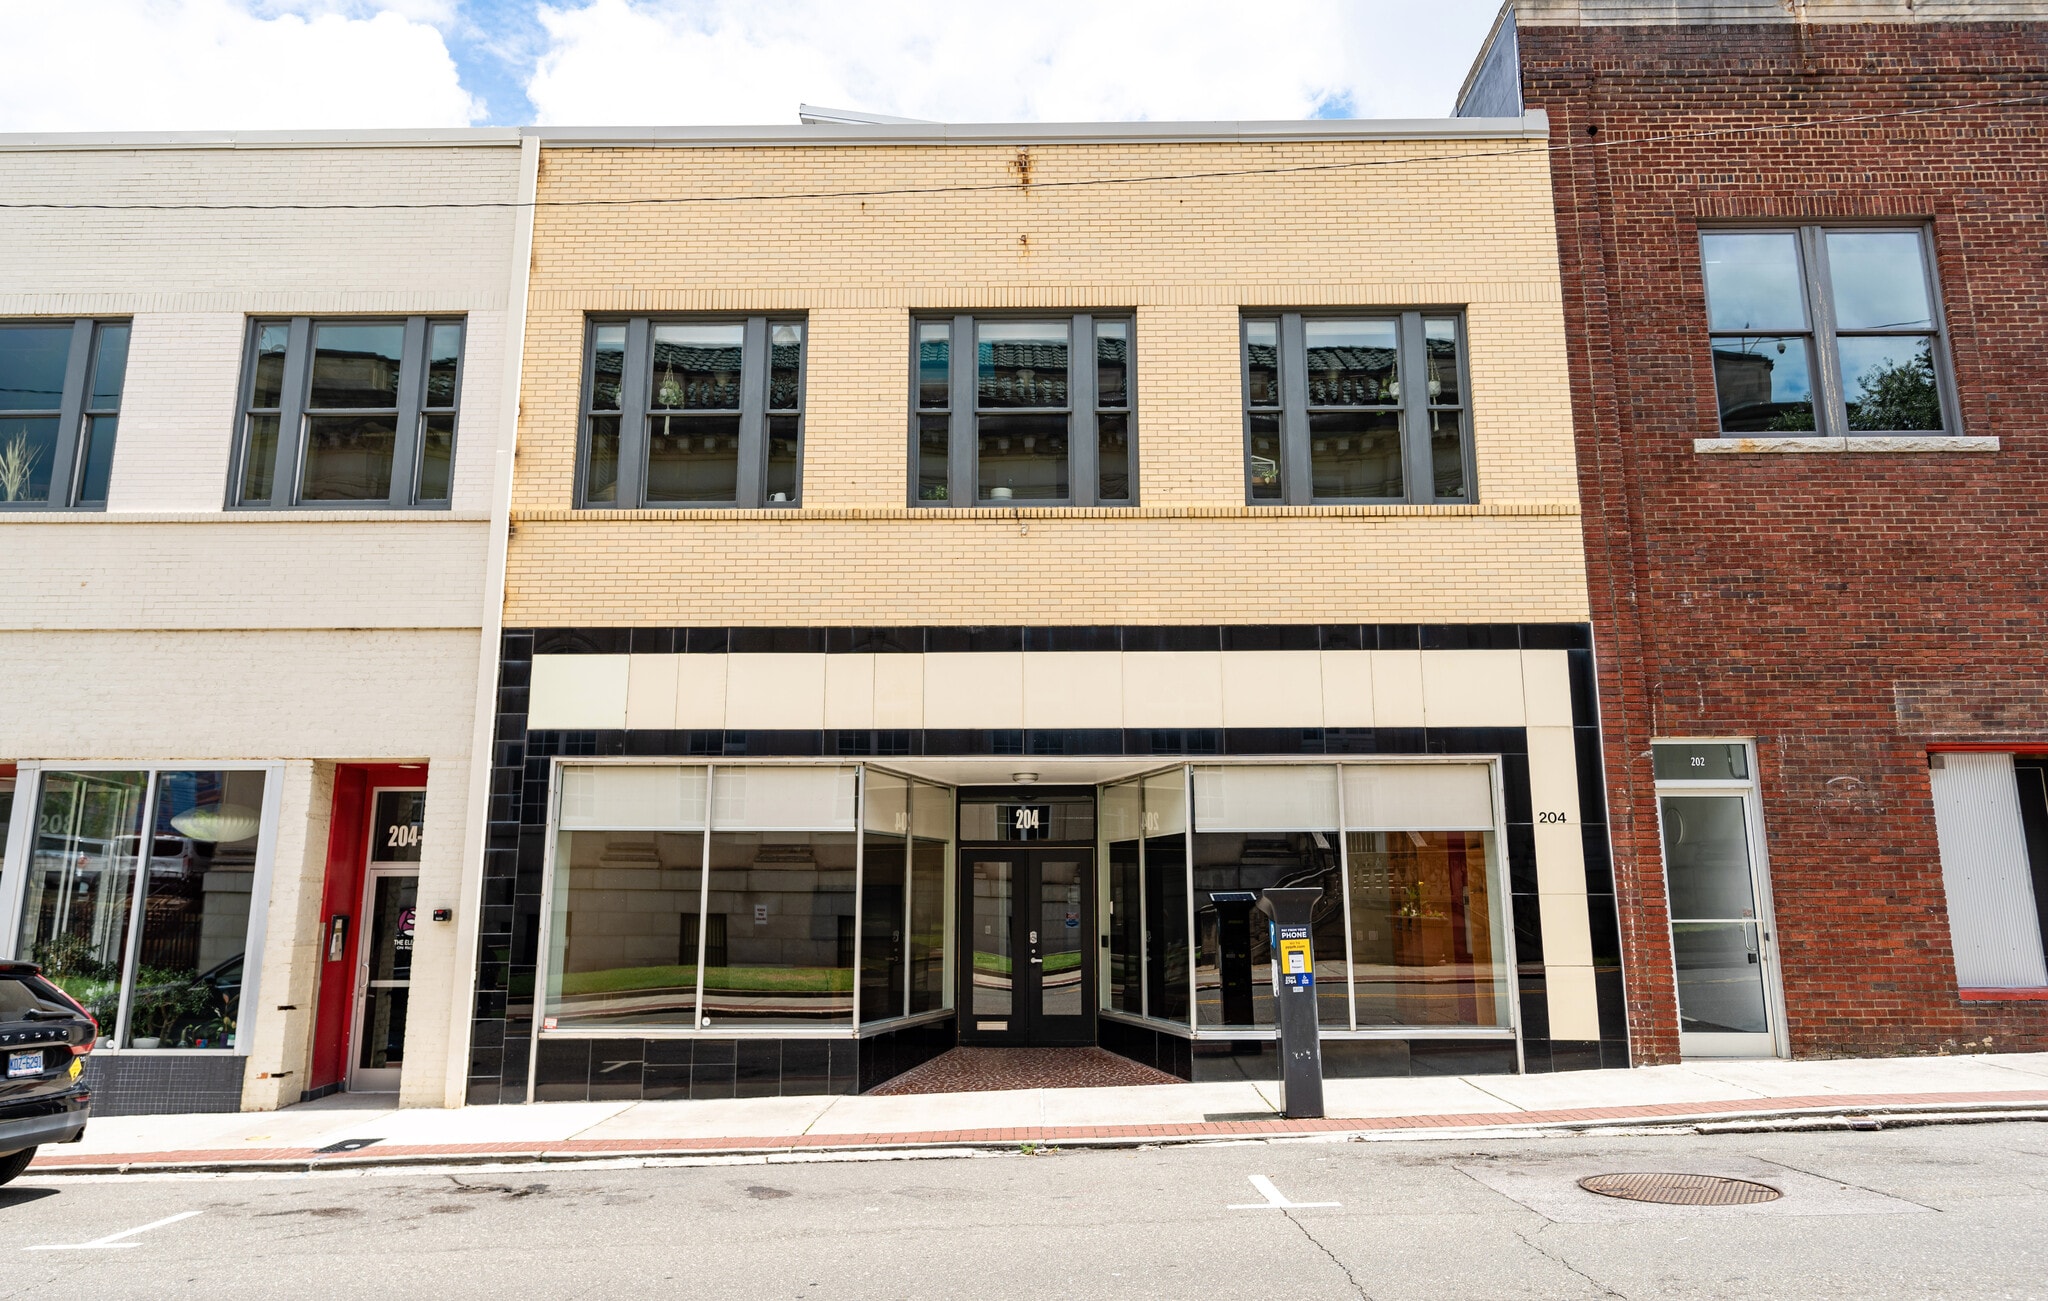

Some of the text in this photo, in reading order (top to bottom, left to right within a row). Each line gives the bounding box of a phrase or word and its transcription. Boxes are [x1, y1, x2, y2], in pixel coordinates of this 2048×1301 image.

[1691, 757, 1705, 767] 202
[1015, 809, 1039, 829] 204
[1538, 811, 1567, 824] 204
[1281, 931, 1307, 939] PHONE
[2, 1030, 68, 1041] VOLVO
